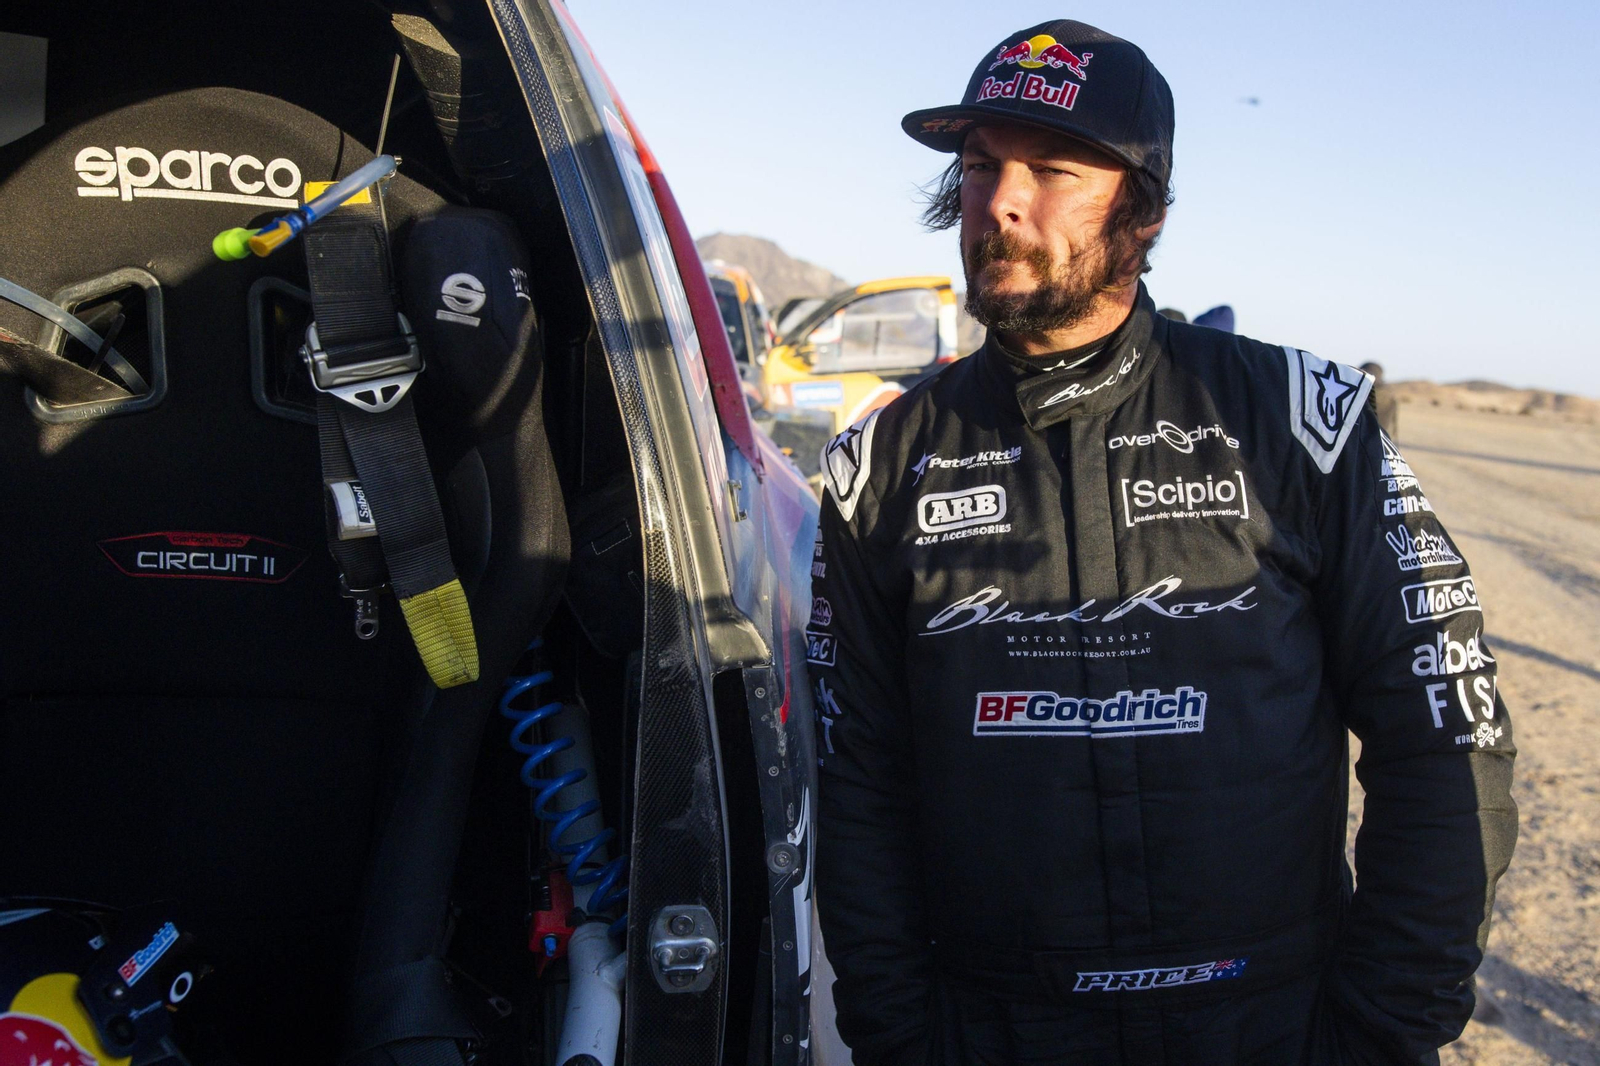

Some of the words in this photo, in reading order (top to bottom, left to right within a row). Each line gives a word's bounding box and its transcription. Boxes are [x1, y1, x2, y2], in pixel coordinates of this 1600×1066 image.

[977, 71, 1024, 102] Red
[1021, 73, 1080, 111] Bull
[74, 146, 302, 201] sparco
[928, 455, 977, 469] Peter
[976, 446, 1022, 462] Kittle
[352, 485, 369, 518] Sabelt
[929, 493, 998, 525] ARB
[1383, 495, 1434, 517] can-a
[1171, 510, 1201, 519] delivery
[1201, 508, 1241, 518] innovation
[941, 523, 1012, 542] ACCESSORIES
[136, 550, 258, 573] CIRCUIT
[918, 585, 1099, 636] Black
[1101, 574, 1259, 624] Rock
[1007, 635, 1067, 644] MOTOR
[1080, 631, 1152, 645] RESORT
[1176, 718, 1200, 730] Tires
[1072, 960, 1217, 992] PRICE
